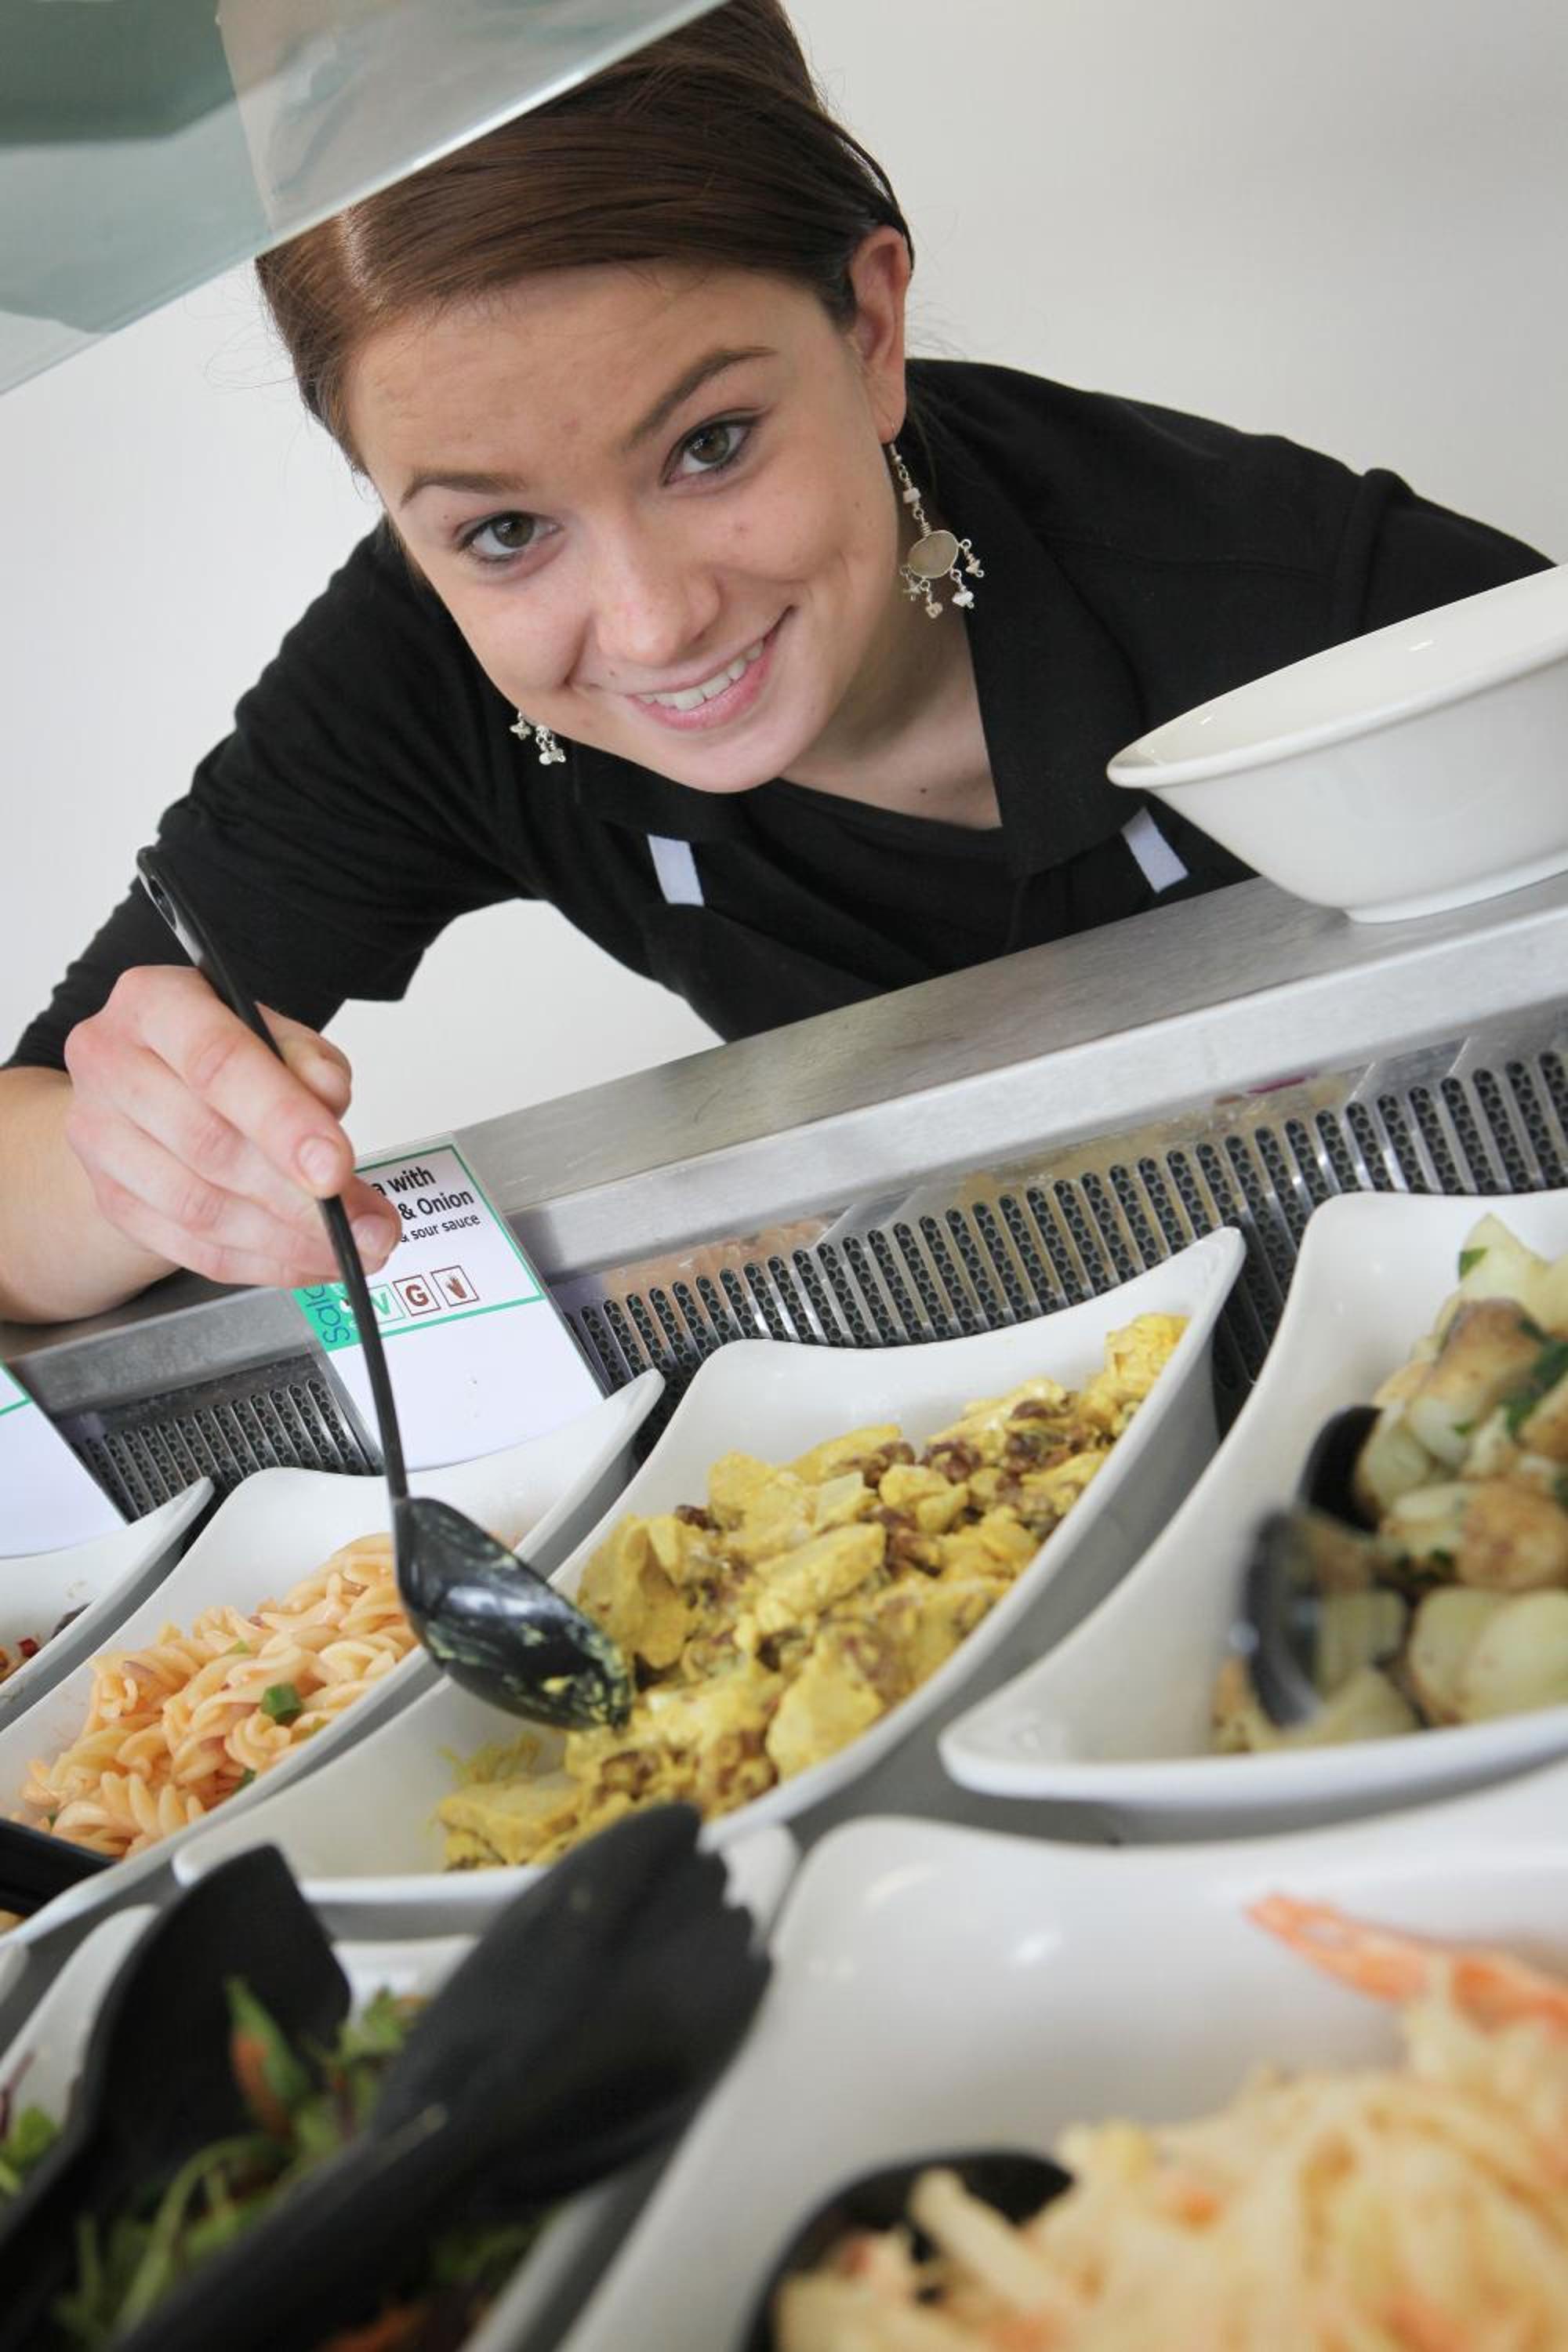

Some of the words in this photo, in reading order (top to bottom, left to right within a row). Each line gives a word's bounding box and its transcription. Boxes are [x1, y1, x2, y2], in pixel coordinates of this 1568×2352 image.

[387, 1167, 437, 1193] with
[398, 1203, 416, 1221] &
[416, 1191, 475, 1216] Onion
[410, 1224, 440, 1240] sour
[441, 1214, 481, 1232] sauce
[405, 1283, 430, 1307] G
